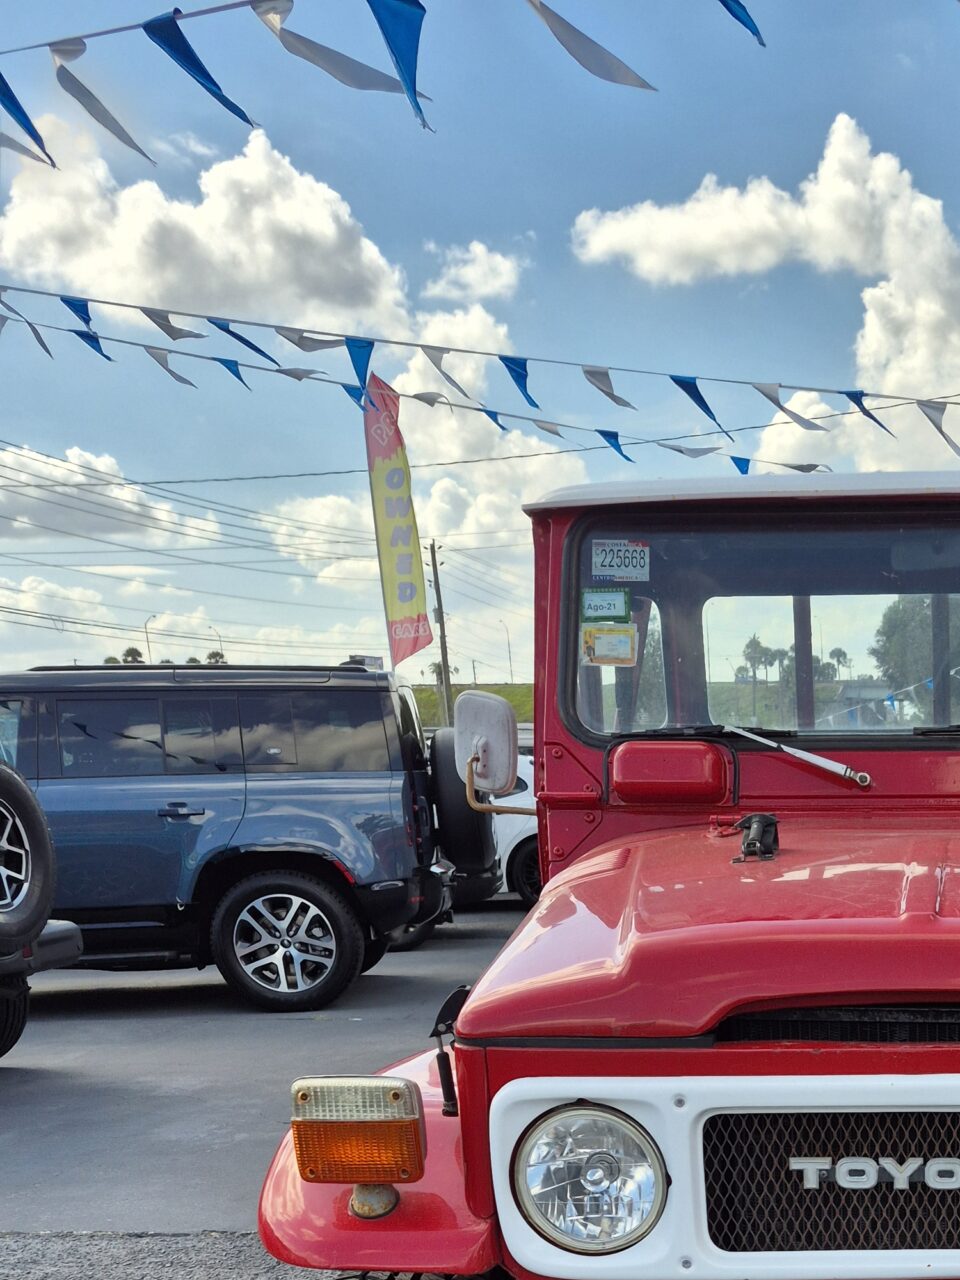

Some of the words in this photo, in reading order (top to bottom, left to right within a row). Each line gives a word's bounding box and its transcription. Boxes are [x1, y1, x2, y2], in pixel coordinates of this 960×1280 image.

[371, 411, 395, 447] PR
[384, 467, 417, 603] OWNED
[600, 549, 646, 568] 225668
[586, 602, 616, 612] Ago-21
[392, 621, 430, 639] CARS
